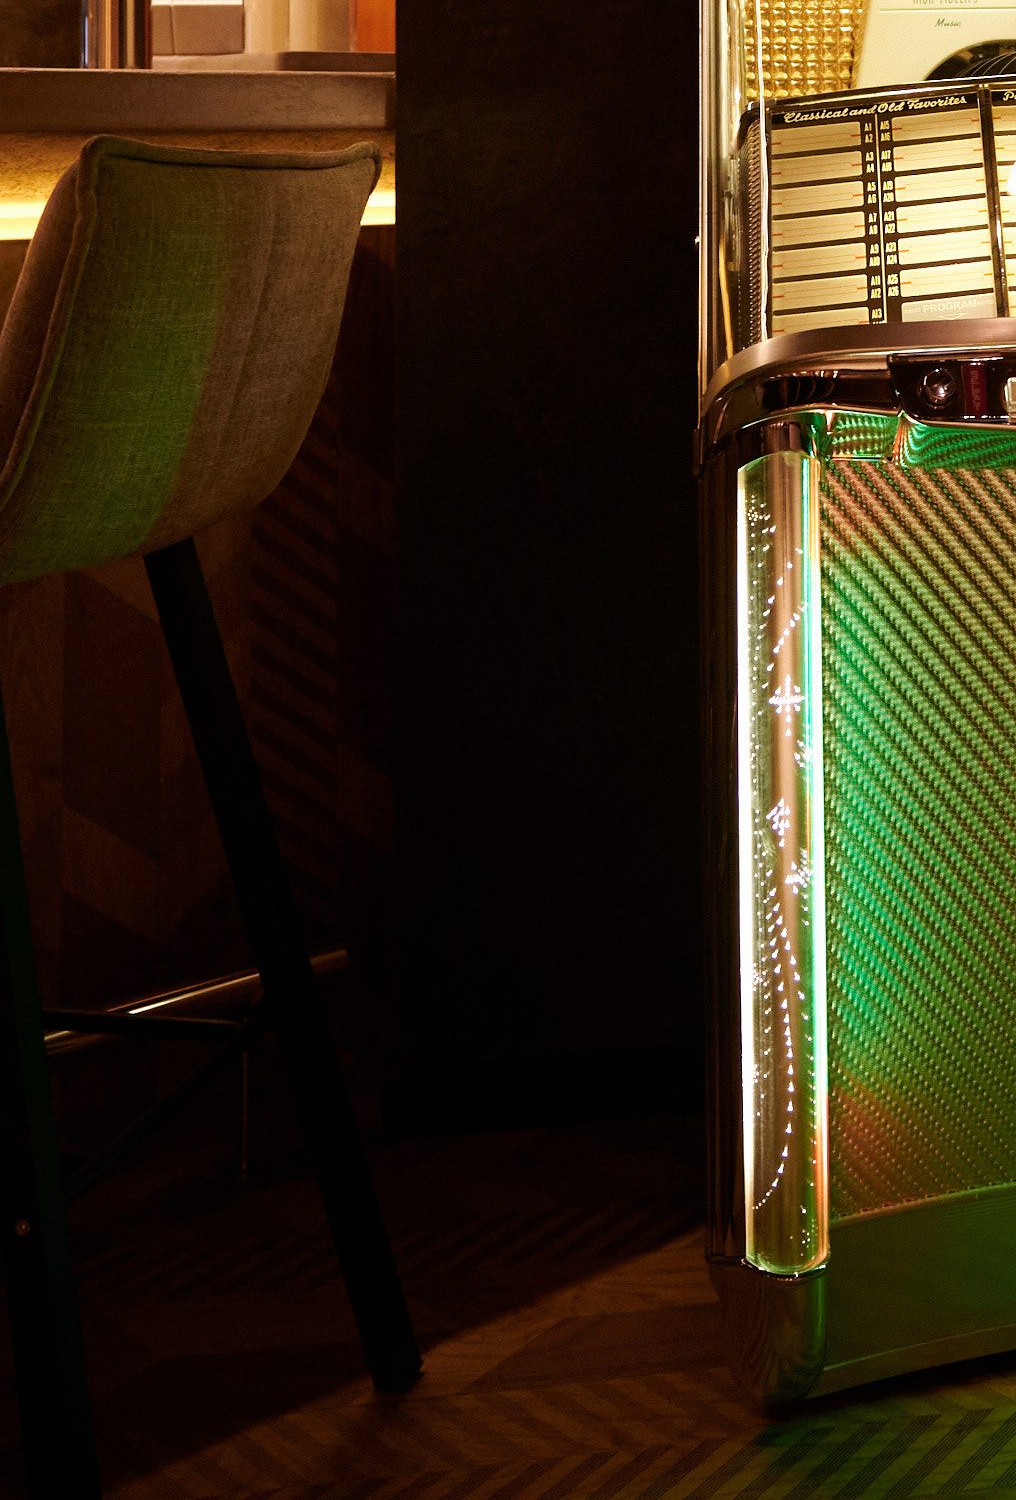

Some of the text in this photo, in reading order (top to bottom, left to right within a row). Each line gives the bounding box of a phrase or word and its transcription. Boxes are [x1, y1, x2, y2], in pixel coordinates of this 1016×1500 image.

[935, 18, 961, 27] Music
[784, 96, 967, 123] Classical and Old Favorites
[865, 123, 871, 131] A1
[880, 121, 889, 130] A15
[865, 134, 873, 143] A2
[881, 132, 890, 141] A16
[866, 152, 874, 161] A3
[881, 150, 891, 159] A17
[867, 164, 874, 173] A4
[882, 162, 892, 172] A18
[867, 182, 876, 191] A5
[883, 181, 893, 190] A19
[868, 194, 876, 203] A6
[883, 192, 894, 202] A20
[869, 213, 877, 223] A7
[884, 211, 894, 221] A21
[869, 225, 878, 235] A8
[885, 223, 895, 233] A22
[870, 244, 879, 254] A9
[886, 242, 896, 252] A23
[869, 256, 880, 267] A10
[887, 254, 897, 264] A24
[871, 275, 880, 286] A11
[888, 274, 898, 285] A25
[871, 288, 881, 299] A12
[888, 286, 899, 297] A26
[924, 300, 977, 312] PROGRAM
[872, 308, 882, 319] A13
